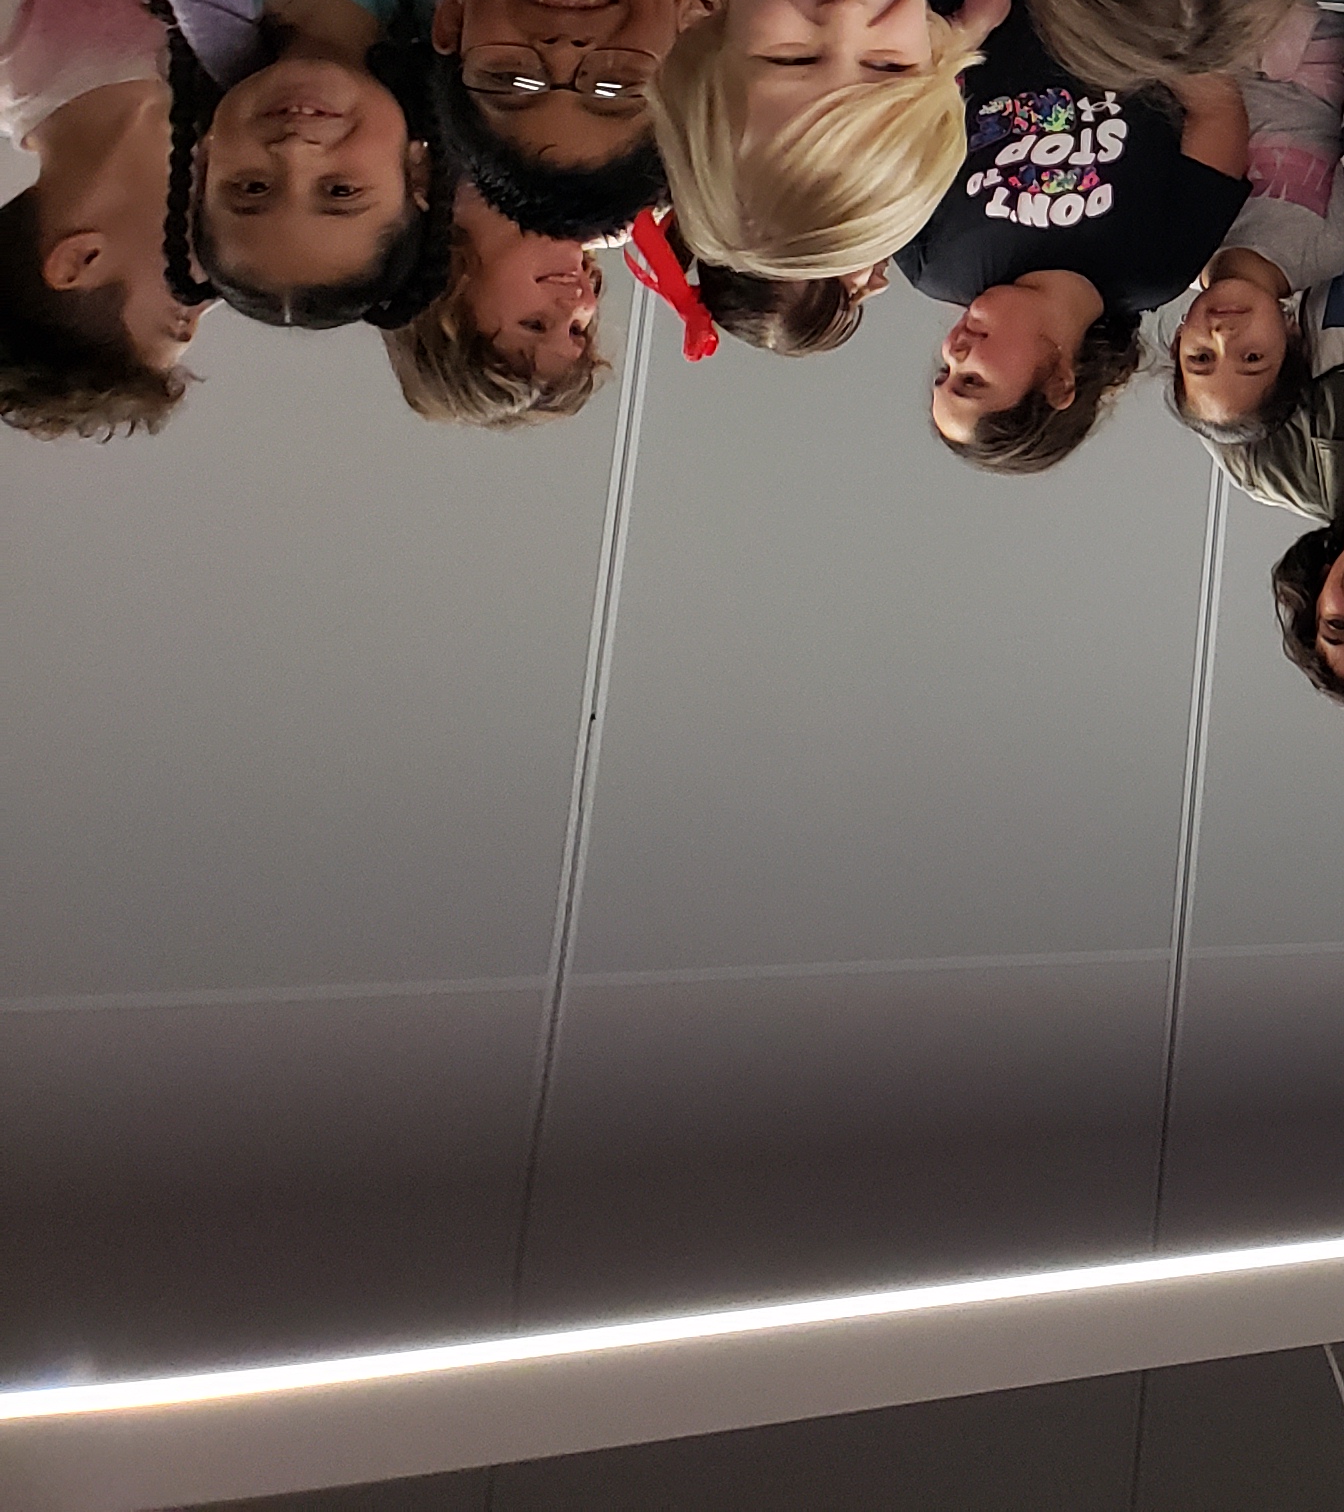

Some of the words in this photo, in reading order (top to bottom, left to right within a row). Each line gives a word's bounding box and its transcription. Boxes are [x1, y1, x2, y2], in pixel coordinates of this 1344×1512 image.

[995, 118, 1127, 165] STOP
[966, 168, 1003, 197] TO
[985, 183, 1112, 228] DON'T
